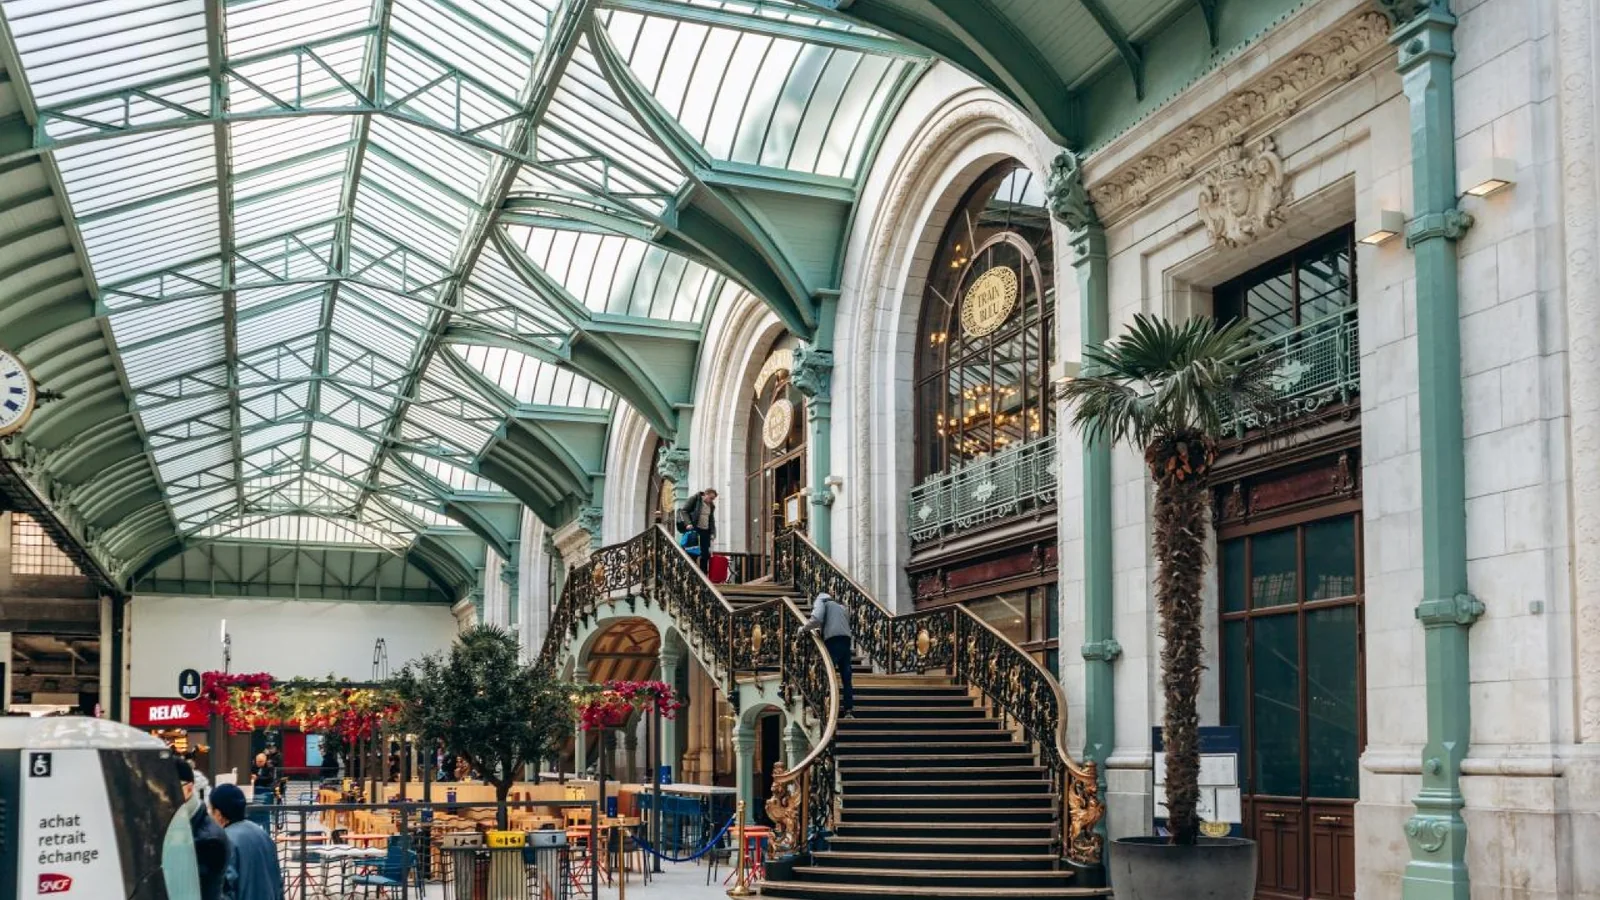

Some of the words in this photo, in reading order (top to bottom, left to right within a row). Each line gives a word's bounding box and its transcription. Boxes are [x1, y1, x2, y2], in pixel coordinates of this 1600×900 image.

[977, 284, 1000, 308] TRAIN
[979, 301, 1000, 322] BLEU
[183, 686, 197, 694] M
[149, 704, 186, 721] RELAY
[39, 814, 81, 829] achat
[38, 831, 86, 847] retrait
[38, 849, 99, 864] échange
[39, 879, 70, 892] SNCF
